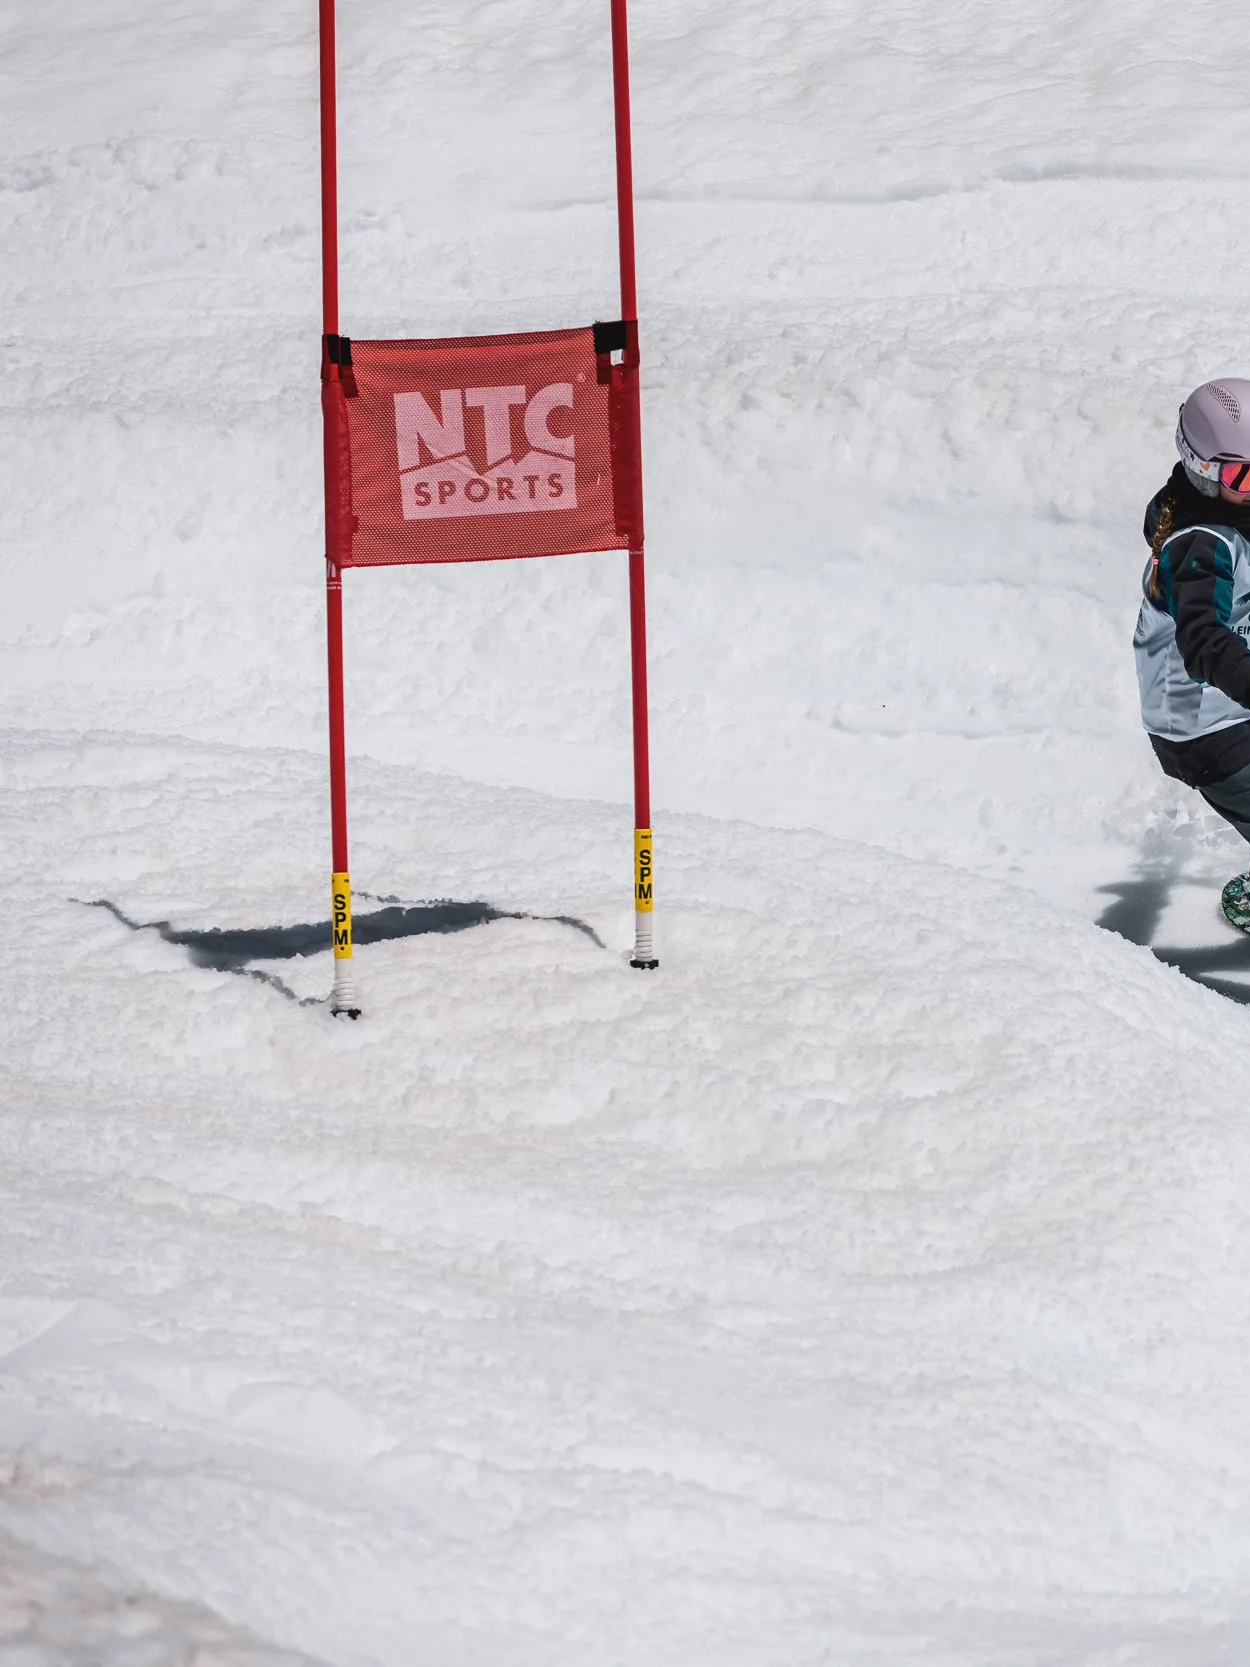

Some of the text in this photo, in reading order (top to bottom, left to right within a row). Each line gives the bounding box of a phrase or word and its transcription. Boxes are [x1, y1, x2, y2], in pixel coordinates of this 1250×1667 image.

[394, 382, 575, 474] NTC
[413, 473, 564, 507] SPORTS
[639, 849, 653, 899] SPM
[333, 893, 349, 946] SPM
